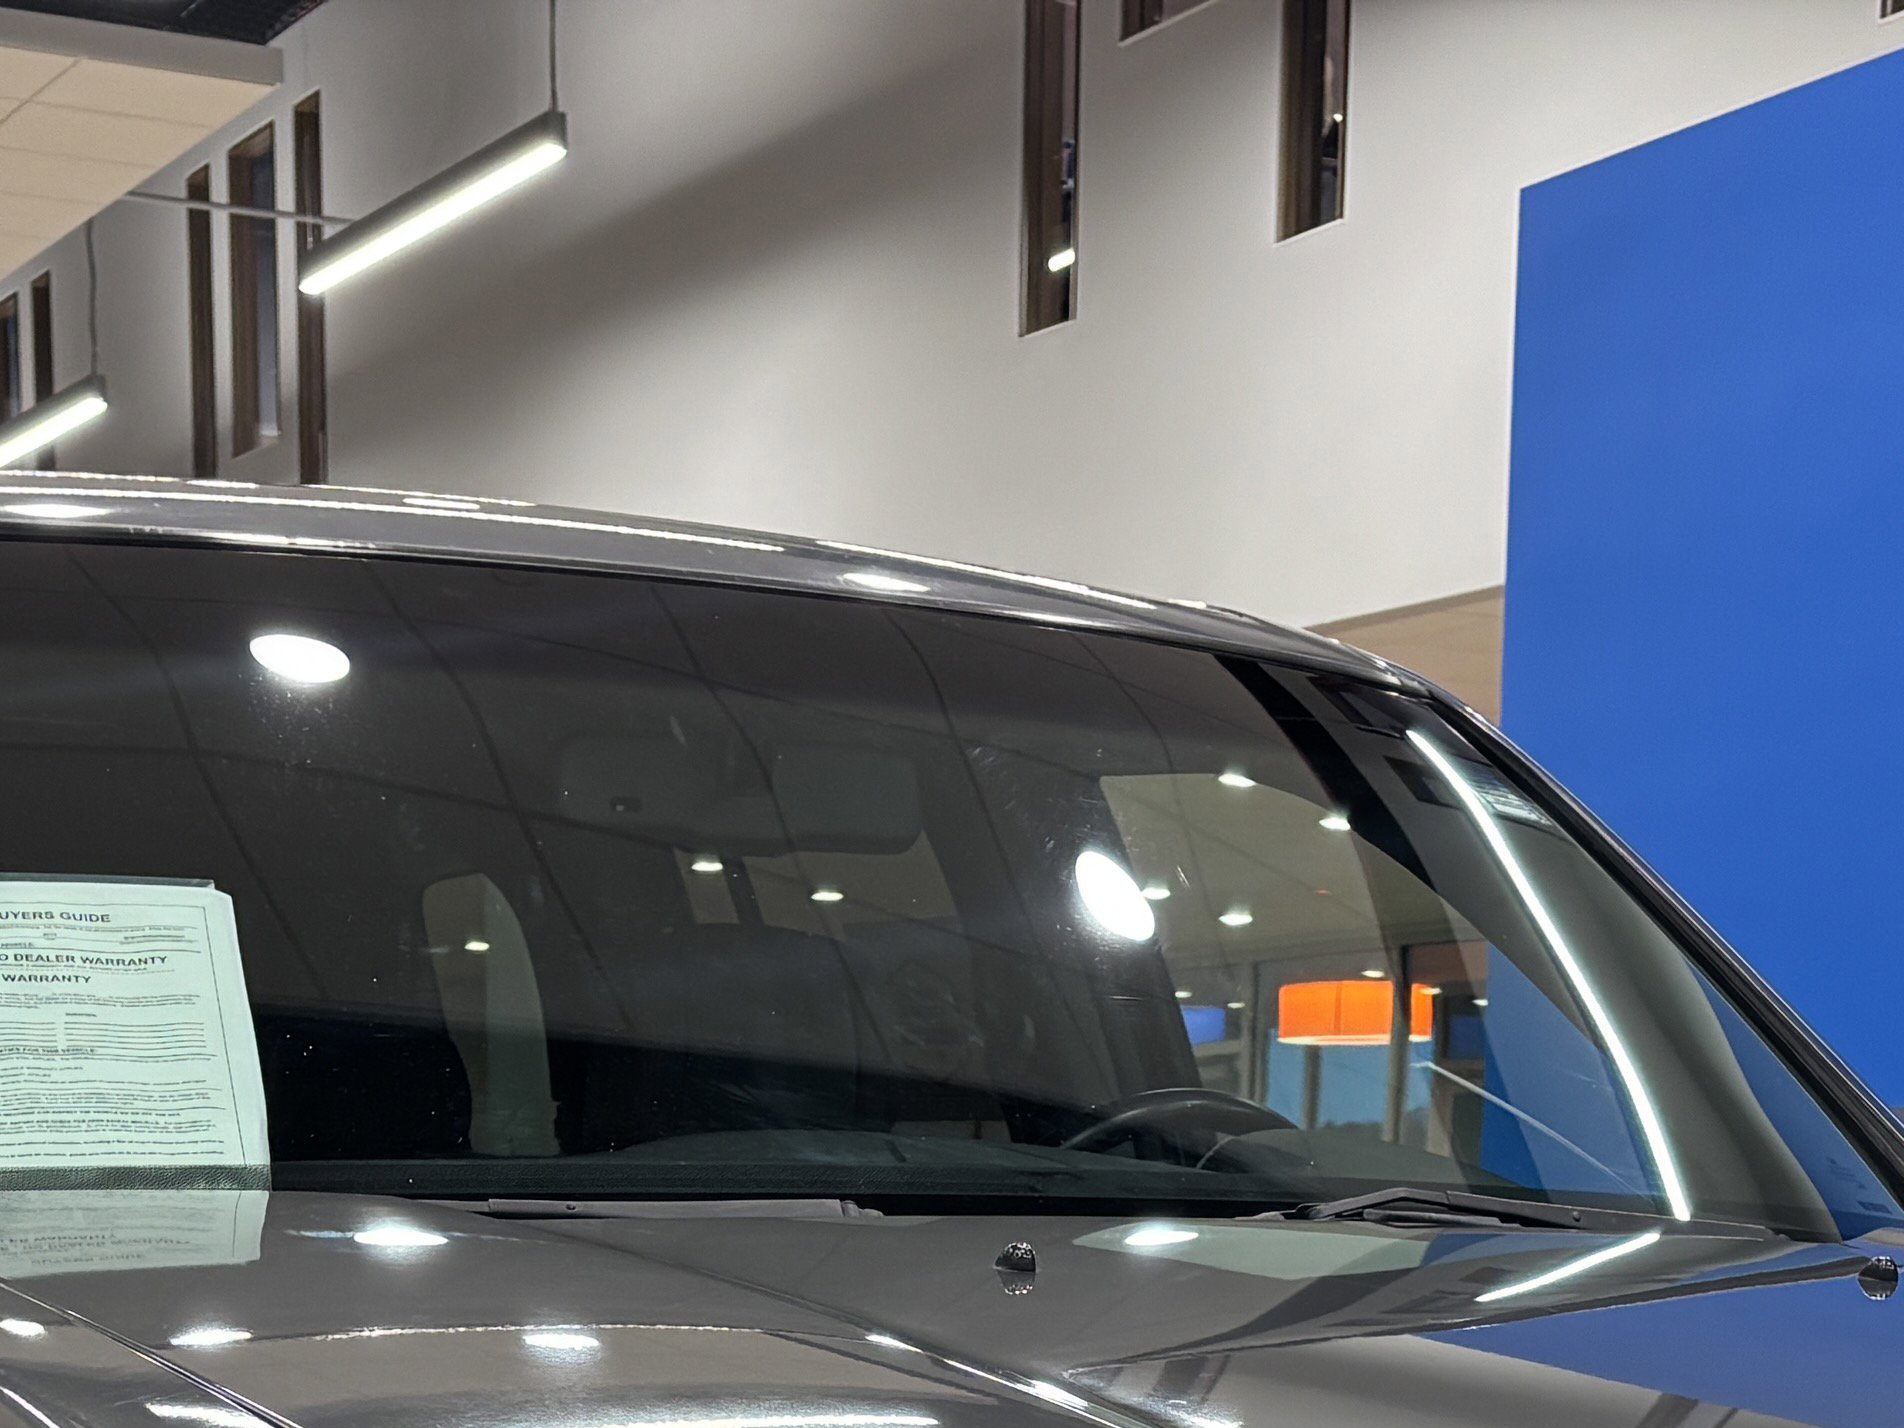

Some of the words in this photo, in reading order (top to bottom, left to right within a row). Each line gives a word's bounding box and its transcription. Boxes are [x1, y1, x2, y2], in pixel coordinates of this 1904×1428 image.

[59, 911, 112, 923] GUIDE
[14, 953, 77, 964] DEALER
[80, 955, 168, 967] WARRANTY
[2, 973, 93, 984] WARRANTY
